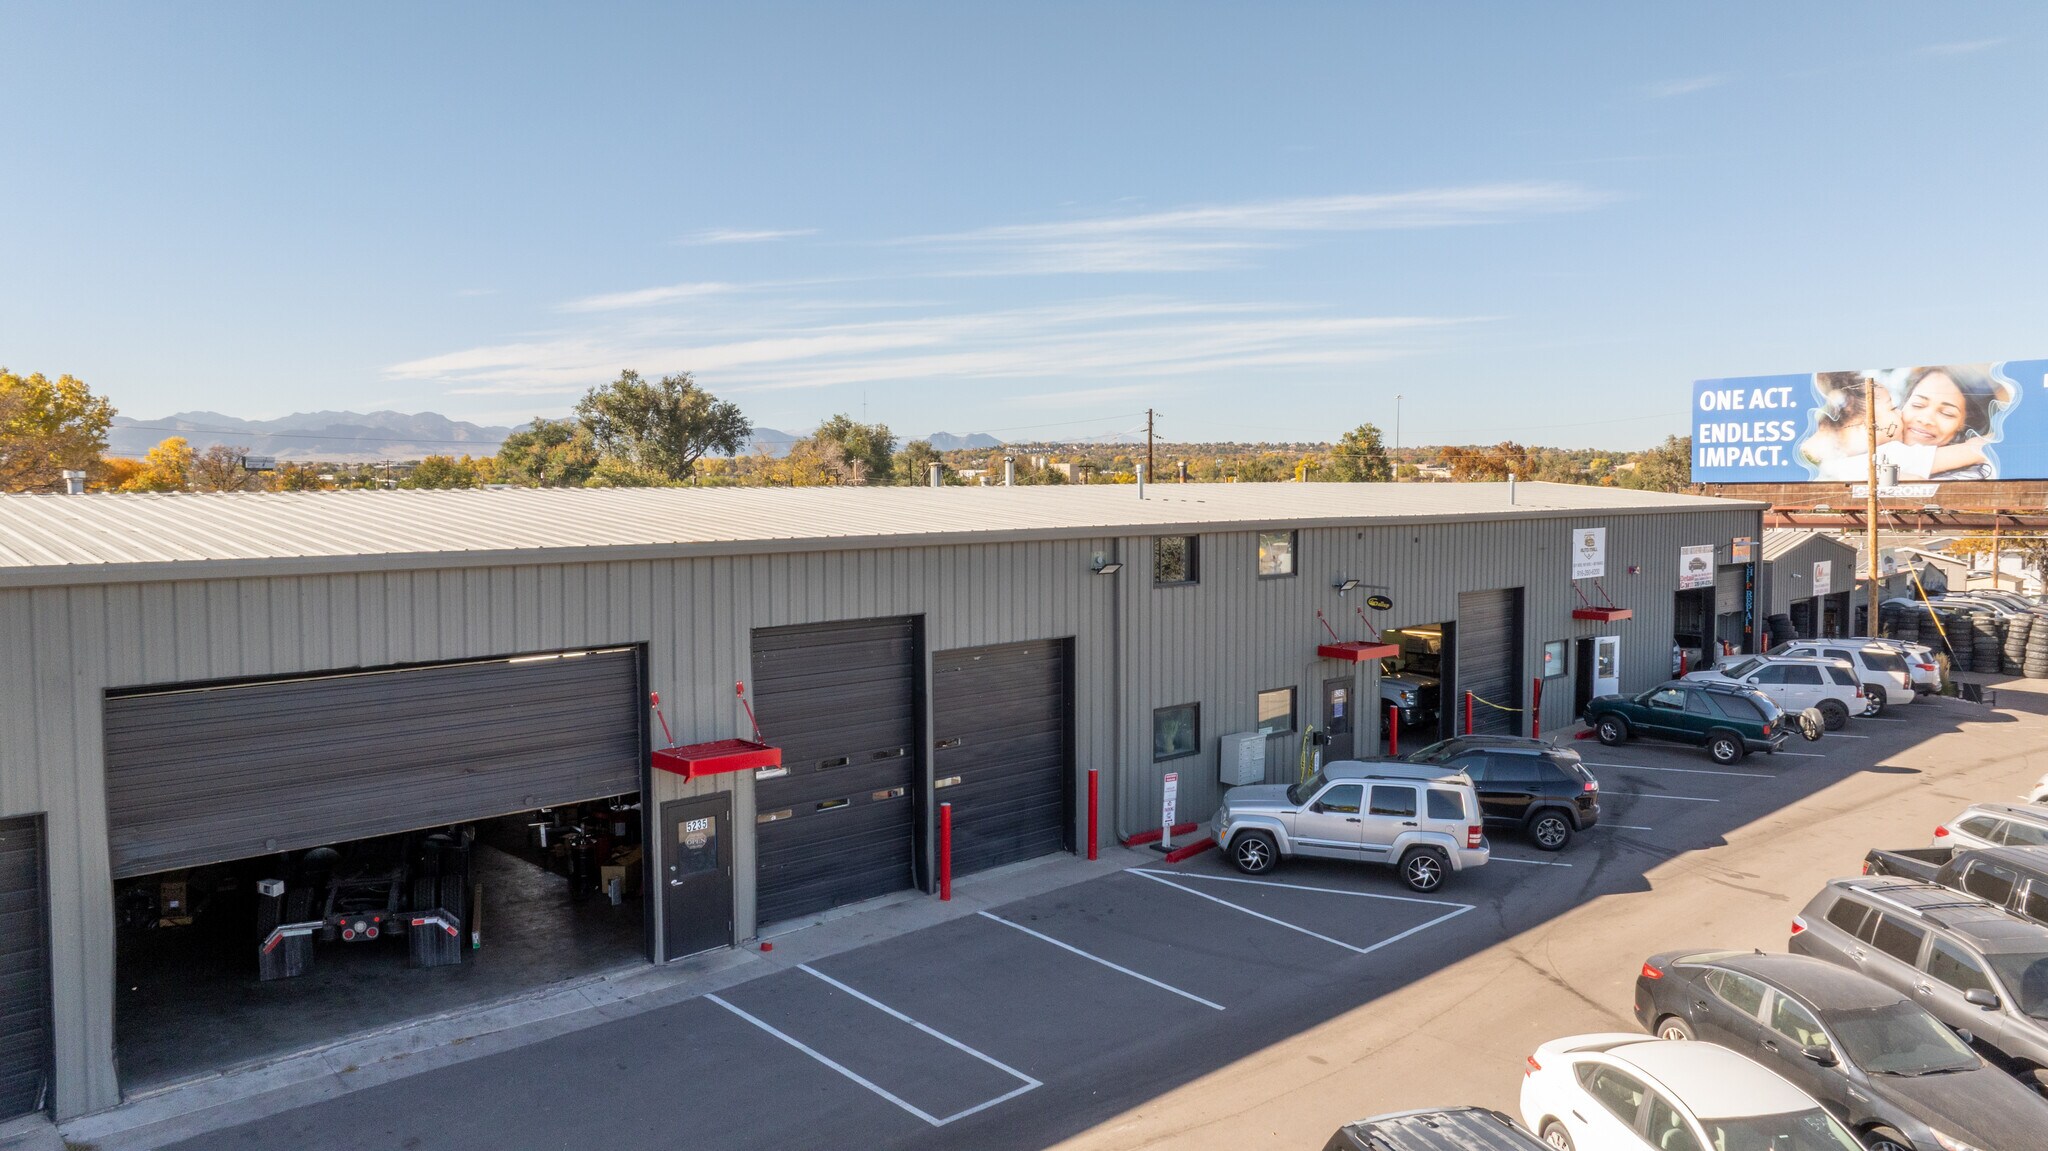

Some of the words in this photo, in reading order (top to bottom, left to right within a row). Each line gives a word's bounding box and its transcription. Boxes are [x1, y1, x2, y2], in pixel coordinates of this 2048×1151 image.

[1700, 389, 1744, 411] ONE
[1749, 387, 1797, 408] ACT.
[1700, 420, 1795, 443] ENDLESS
[1700, 446, 1788, 467] IMPACT.
[688, 820, 706, 832] 5235
